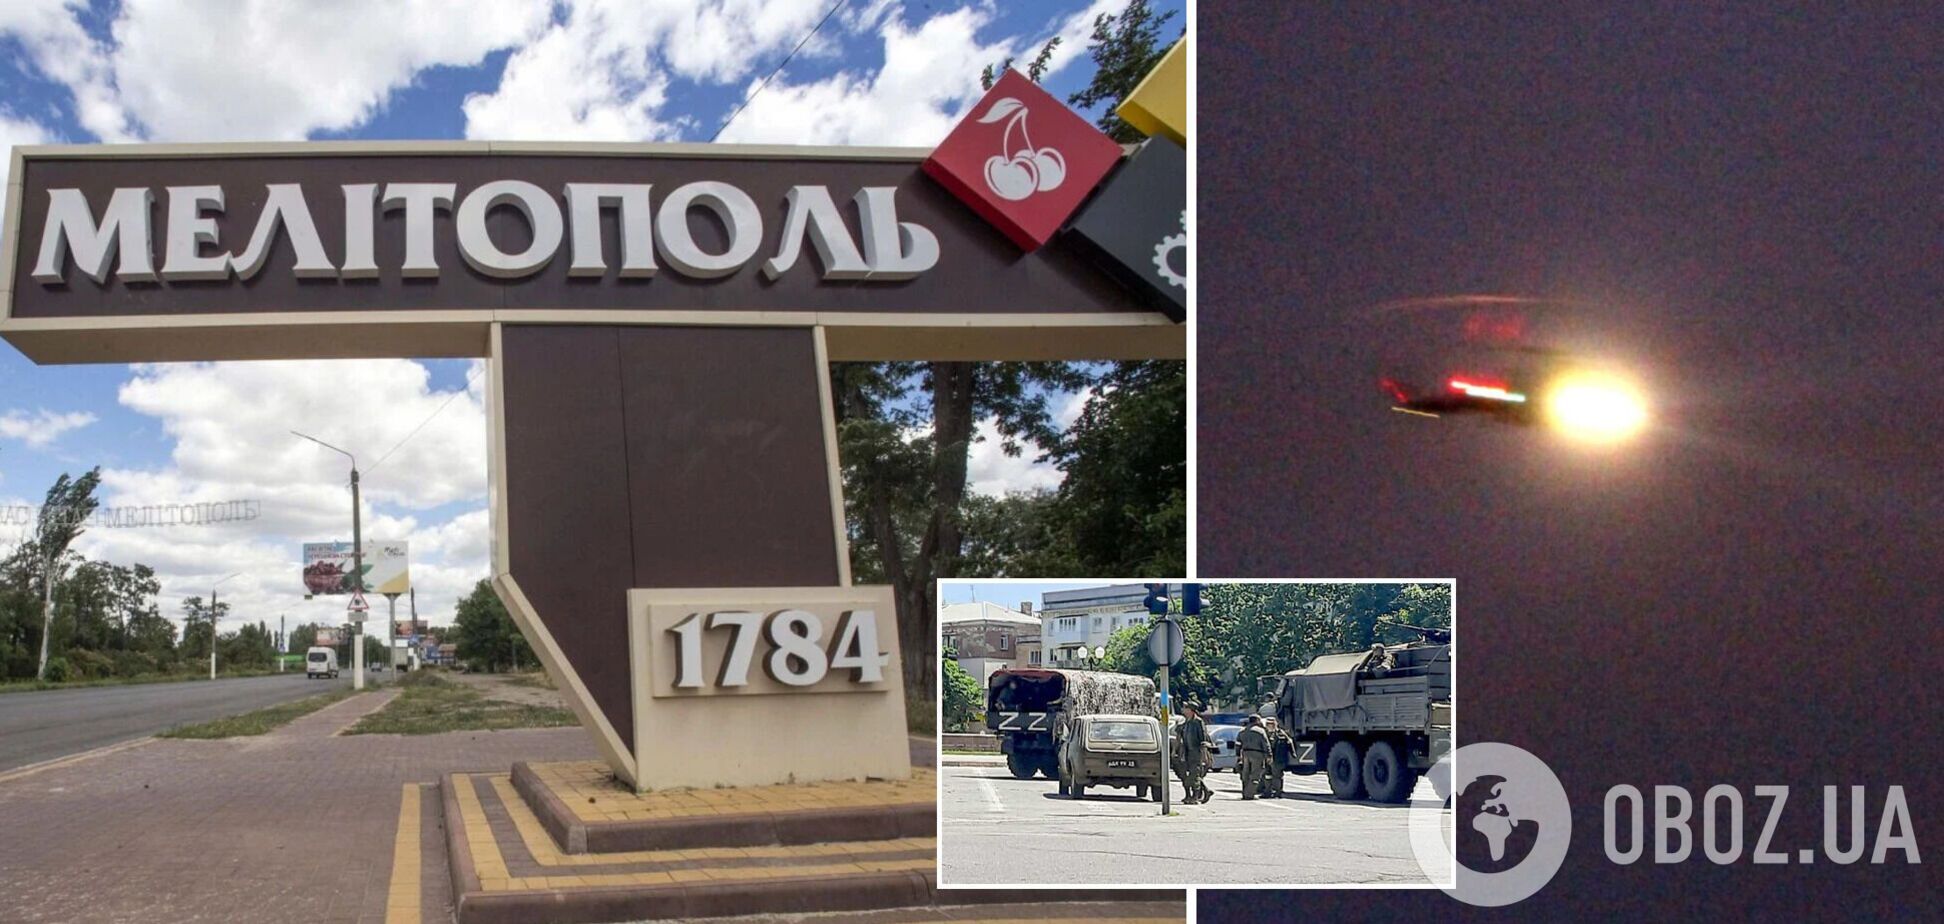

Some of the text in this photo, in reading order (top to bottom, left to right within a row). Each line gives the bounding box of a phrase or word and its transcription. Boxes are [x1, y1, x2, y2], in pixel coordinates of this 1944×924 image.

[31, 180, 940, 285] МЕЛІТОПОЛЬ
[665, 608, 889, 690] 1784
[1299, 743, 1314, 763] Z
